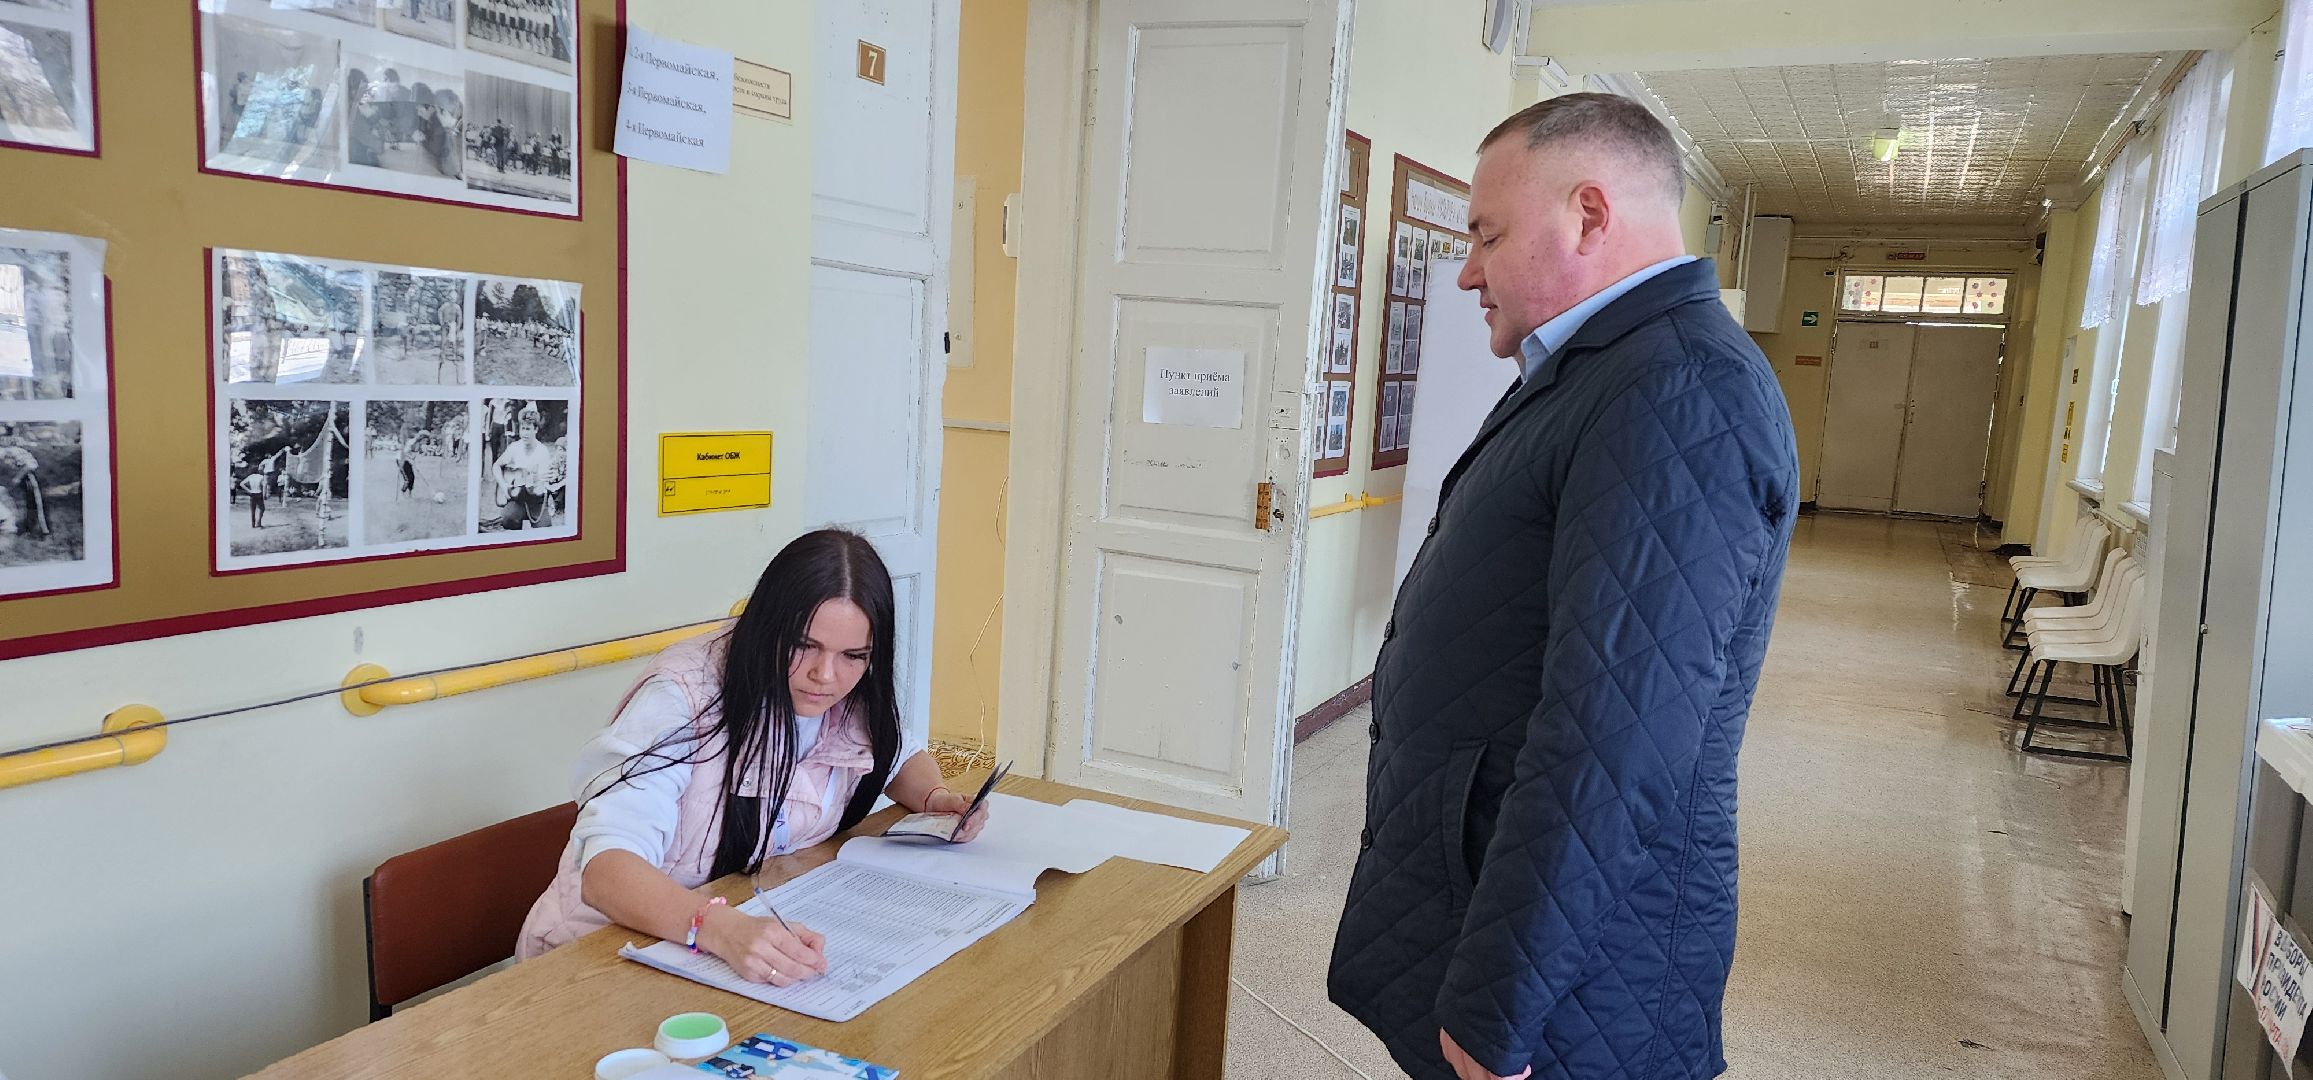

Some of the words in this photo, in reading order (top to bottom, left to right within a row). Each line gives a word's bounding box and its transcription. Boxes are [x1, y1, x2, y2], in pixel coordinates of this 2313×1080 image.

[868, 50, 878, 77] 7
[1160, 368, 1190, 382] Пункт
[1194, 371, 1231, 383] приёма
[1168, 386, 1220, 398] заявлений
